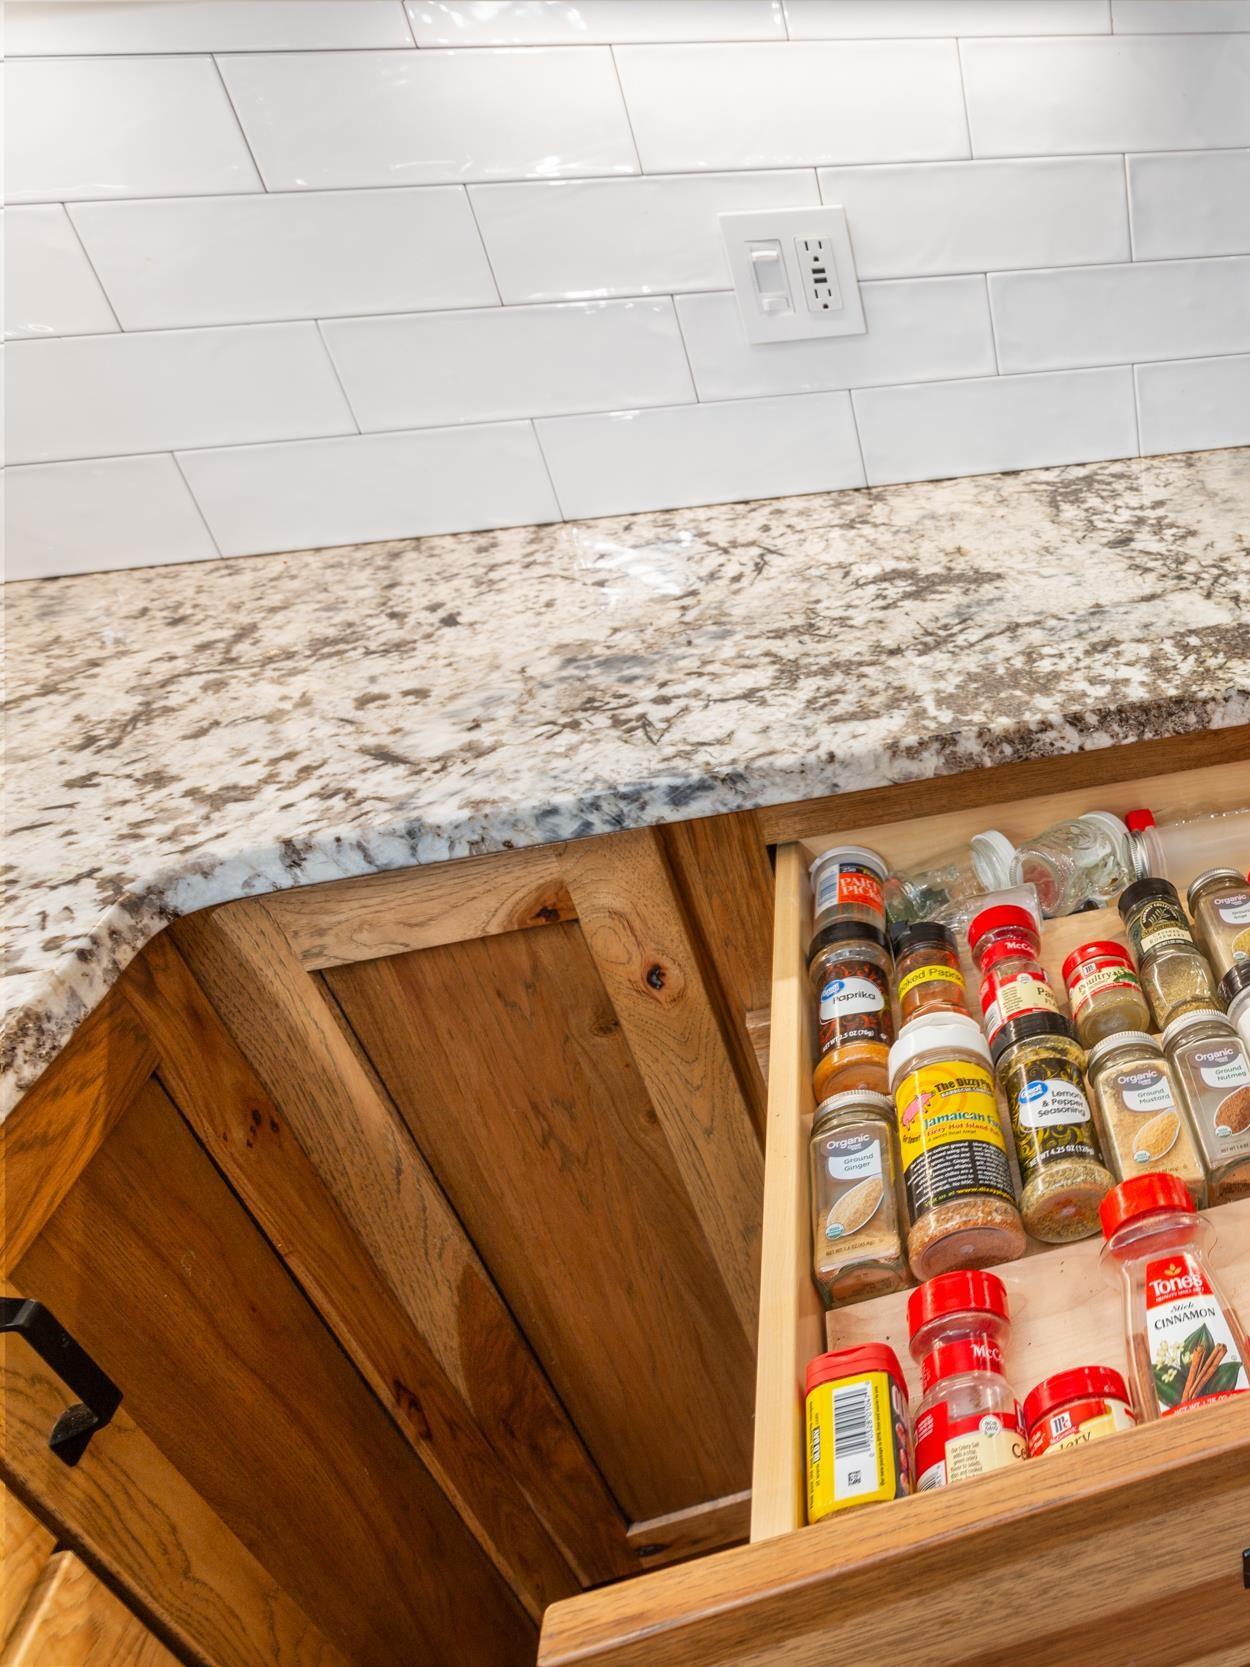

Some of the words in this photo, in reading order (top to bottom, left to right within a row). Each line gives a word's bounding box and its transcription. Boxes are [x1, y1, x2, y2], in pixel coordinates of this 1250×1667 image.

[1214, 894, 1247, 905] Organic
[832, 990, 876, 1004] Paprika
[1194, 1048, 1234, 1062] Organic
[1215, 1064, 1242, 1075] Ground
[1117, 1069, 1158, 1085] Organic
[1217, 1070, 1247, 1081] Nutmeg
[934, 1080, 956, 1093] The
[1051, 1090, 1082, 1100] Lemon
[1137, 1088, 1165, 1099] Ground
[1139, 1093, 1171, 1105] Mustard
[1052, 1098, 1083, 1107] Pepper
[1038, 1107, 1086, 1118] Seasoning
[925, 1111, 985, 1130] Jamaican
[826, 1133, 870, 1149] Organic
[843, 1153, 874, 1165] Ground
[844, 1161, 871, 1172] Ginger
[1170, 1302, 1195, 1313] Stick
[1154, 1307, 1216, 1331] CINNAMON
